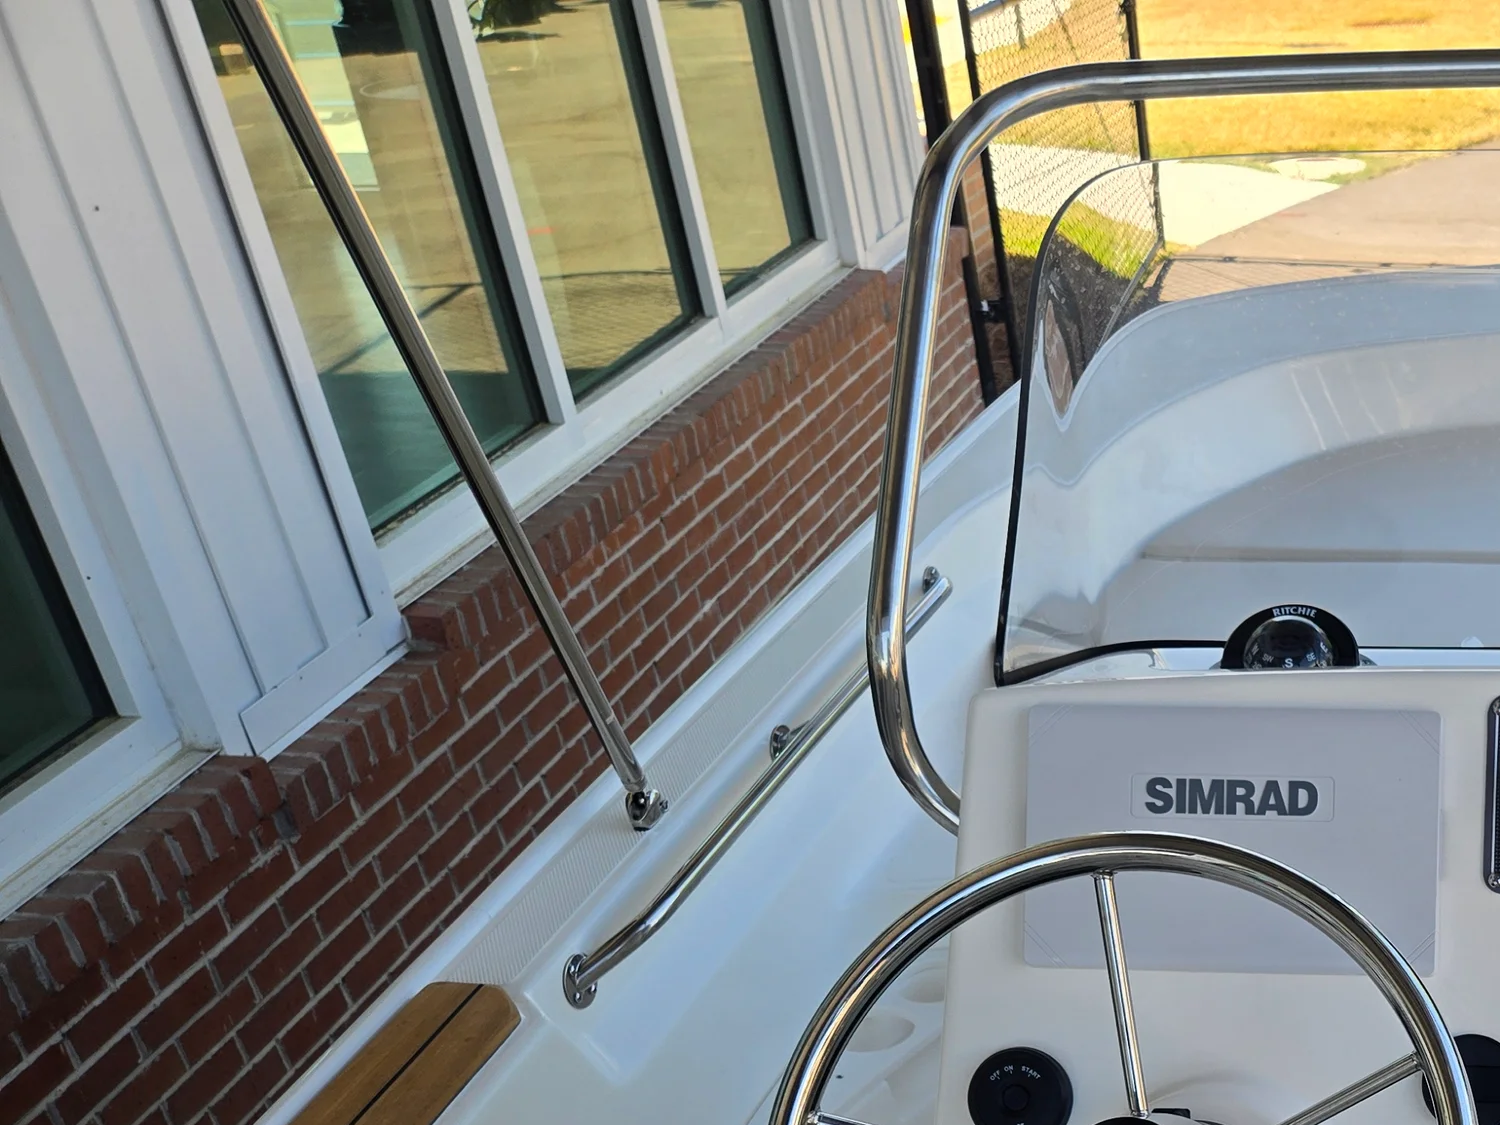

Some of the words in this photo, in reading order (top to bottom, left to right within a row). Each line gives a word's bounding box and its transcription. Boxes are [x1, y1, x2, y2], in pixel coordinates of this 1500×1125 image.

[1272, 606, 1317, 618] RITCHIE
[1285, 658, 1293, 668] S
[1144, 776, 1319, 816] SIMRAD
[1021, 1065, 1040, 1079] START
